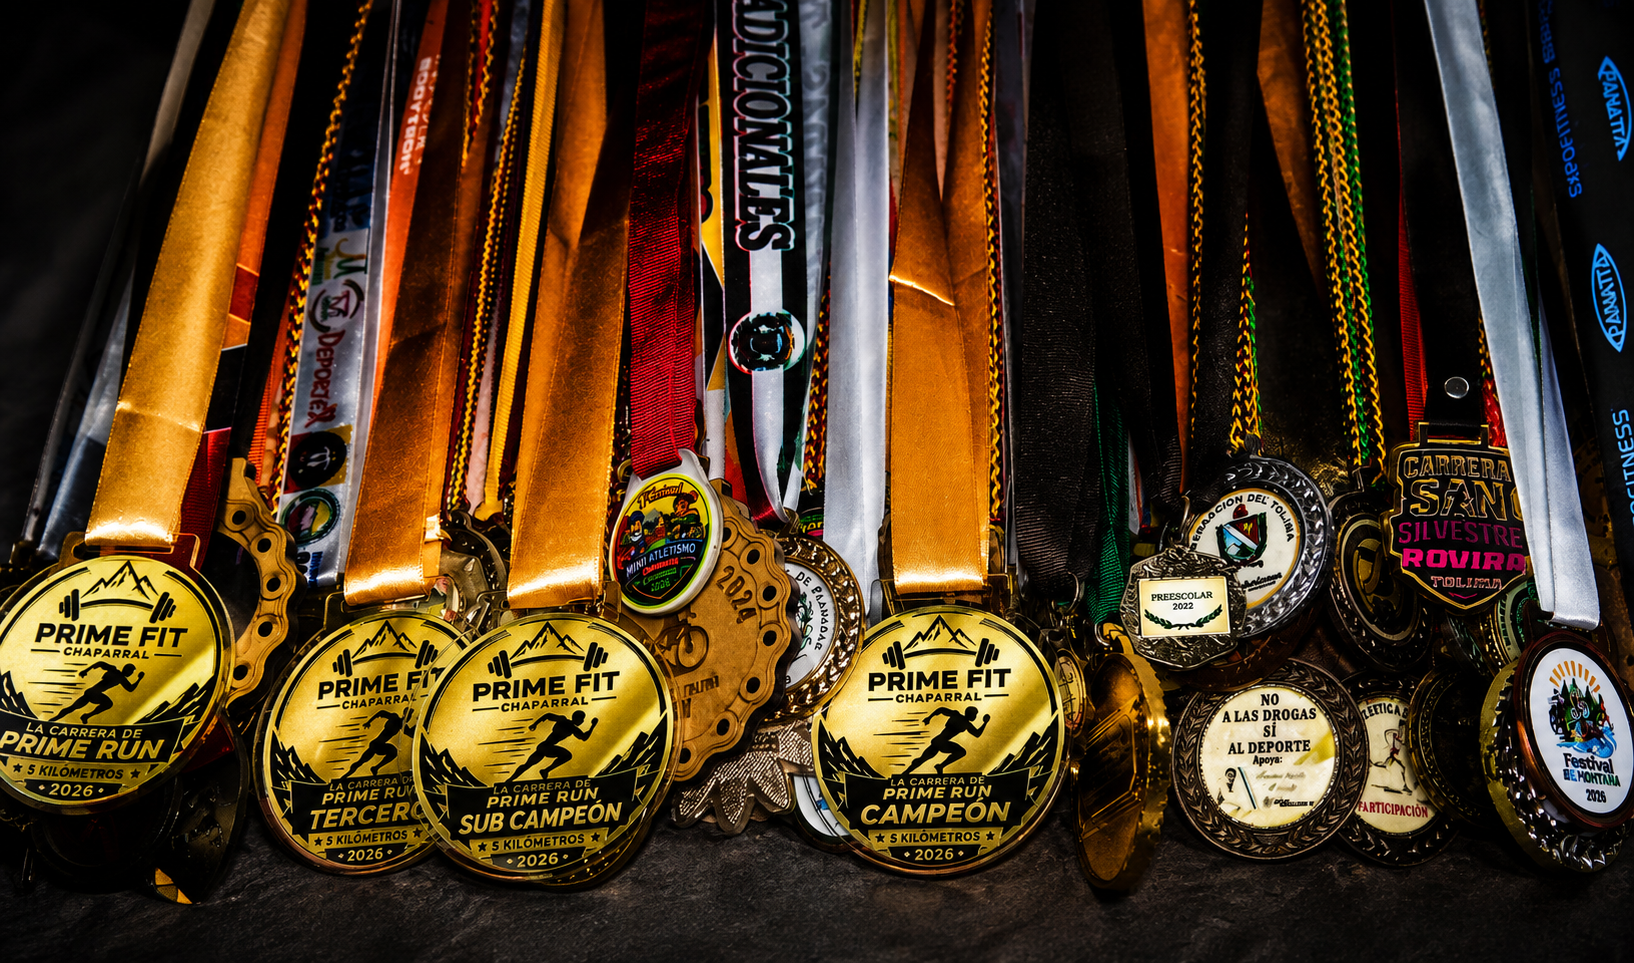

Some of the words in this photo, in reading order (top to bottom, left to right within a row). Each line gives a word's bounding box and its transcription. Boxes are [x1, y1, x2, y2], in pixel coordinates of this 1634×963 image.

[1403, 455, 1512, 482] CARRERA
[1247, 493, 1267, 505] DEL
[1398, 520, 1523, 549] SILVESTRE
[648, 543, 696, 563] ATLETISMO
[1401, 548, 1526, 571] ROVIRA
[795, 571, 811, 587] DE
[715, 565, 757, 624] 2024
[1151, 591, 1213, 602] PREESCOLAR
[1172, 602, 1194, 611] 2022
[34, 623, 133, 647] PRIME
[139, 626, 189, 648] FIT
[63, 646, 150, 660] CHAPARRAL
[317, 674, 399, 700] PRIME
[472, 675, 566, 702] PRIME
[575, 671, 620, 694] FIT
[868, 669, 959, 691] PRIME
[967, 668, 1012, 689] FIT
[342, 693, 417, 710] CHAPARRAL
[501, 696, 589, 713] CHAPARRAL
[895, 692, 982, 704] CHAPARRAL
[1260, 693, 1280, 706] NO
[1222, 711, 1232, 723] A
[1234, 710, 1260, 722] LAS
[1262, 708, 1317, 721] DROGAS
[25, 721, 38, 735] LA
[49, 725, 117, 739] CARRERA
[122, 728, 143, 740] DE
[1263, 722, 1277, 738] SÍ
[0, 730, 92, 759] PRIME
[95, 739, 165, 760] RUN
[1228, 743, 1246, 755] AL
[1247, 740, 1311, 754] DEPORTE
[1252, 754, 1283, 767] Apoya:
[1562, 753, 1615, 774] Festival
[27, 764, 36, 775] 5
[38, 763, 124, 780] KILÓMETROS
[329, 782, 343, 792] LA
[347, 777, 398, 790] CARRERA
[402, 775, 414, 785] D
[493, 786, 510, 795] LA
[513, 780, 571, 794] CARRERA
[575, 779, 592, 789] DE
[890, 777, 905, 787] LA
[909, 776, 965, 787] CARRERA
[970, 775, 985, 785] DE
[48, 783, 94, 797] 2026
[321, 788, 380, 805] PRIME
[486, 789, 550, 809] PRIME
[556, 787, 599, 804] RUN
[882, 786, 945, 800] PRIME
[950, 785, 992, 798] RUN
[1585, 788, 1607, 803] 2026
[310, 801, 426, 830] TERCERO
[458, 813, 504, 835] SUB
[509, 799, 623, 831] CAMPEÓN
[860, 797, 1011, 825] CAMPEÓN
[326, 835, 334, 846] 5
[336, 829, 408, 846] KILÓMETROS
[491, 841, 500, 851] 5
[503, 834, 585, 851] KILÓMETROS
[890, 833, 898, 844] 5
[900, 829, 980, 843] KILÓMETROS
[347, 849, 383, 862] 2026
[517, 853, 559, 868] 2026
[915, 848, 954, 861] 2026
